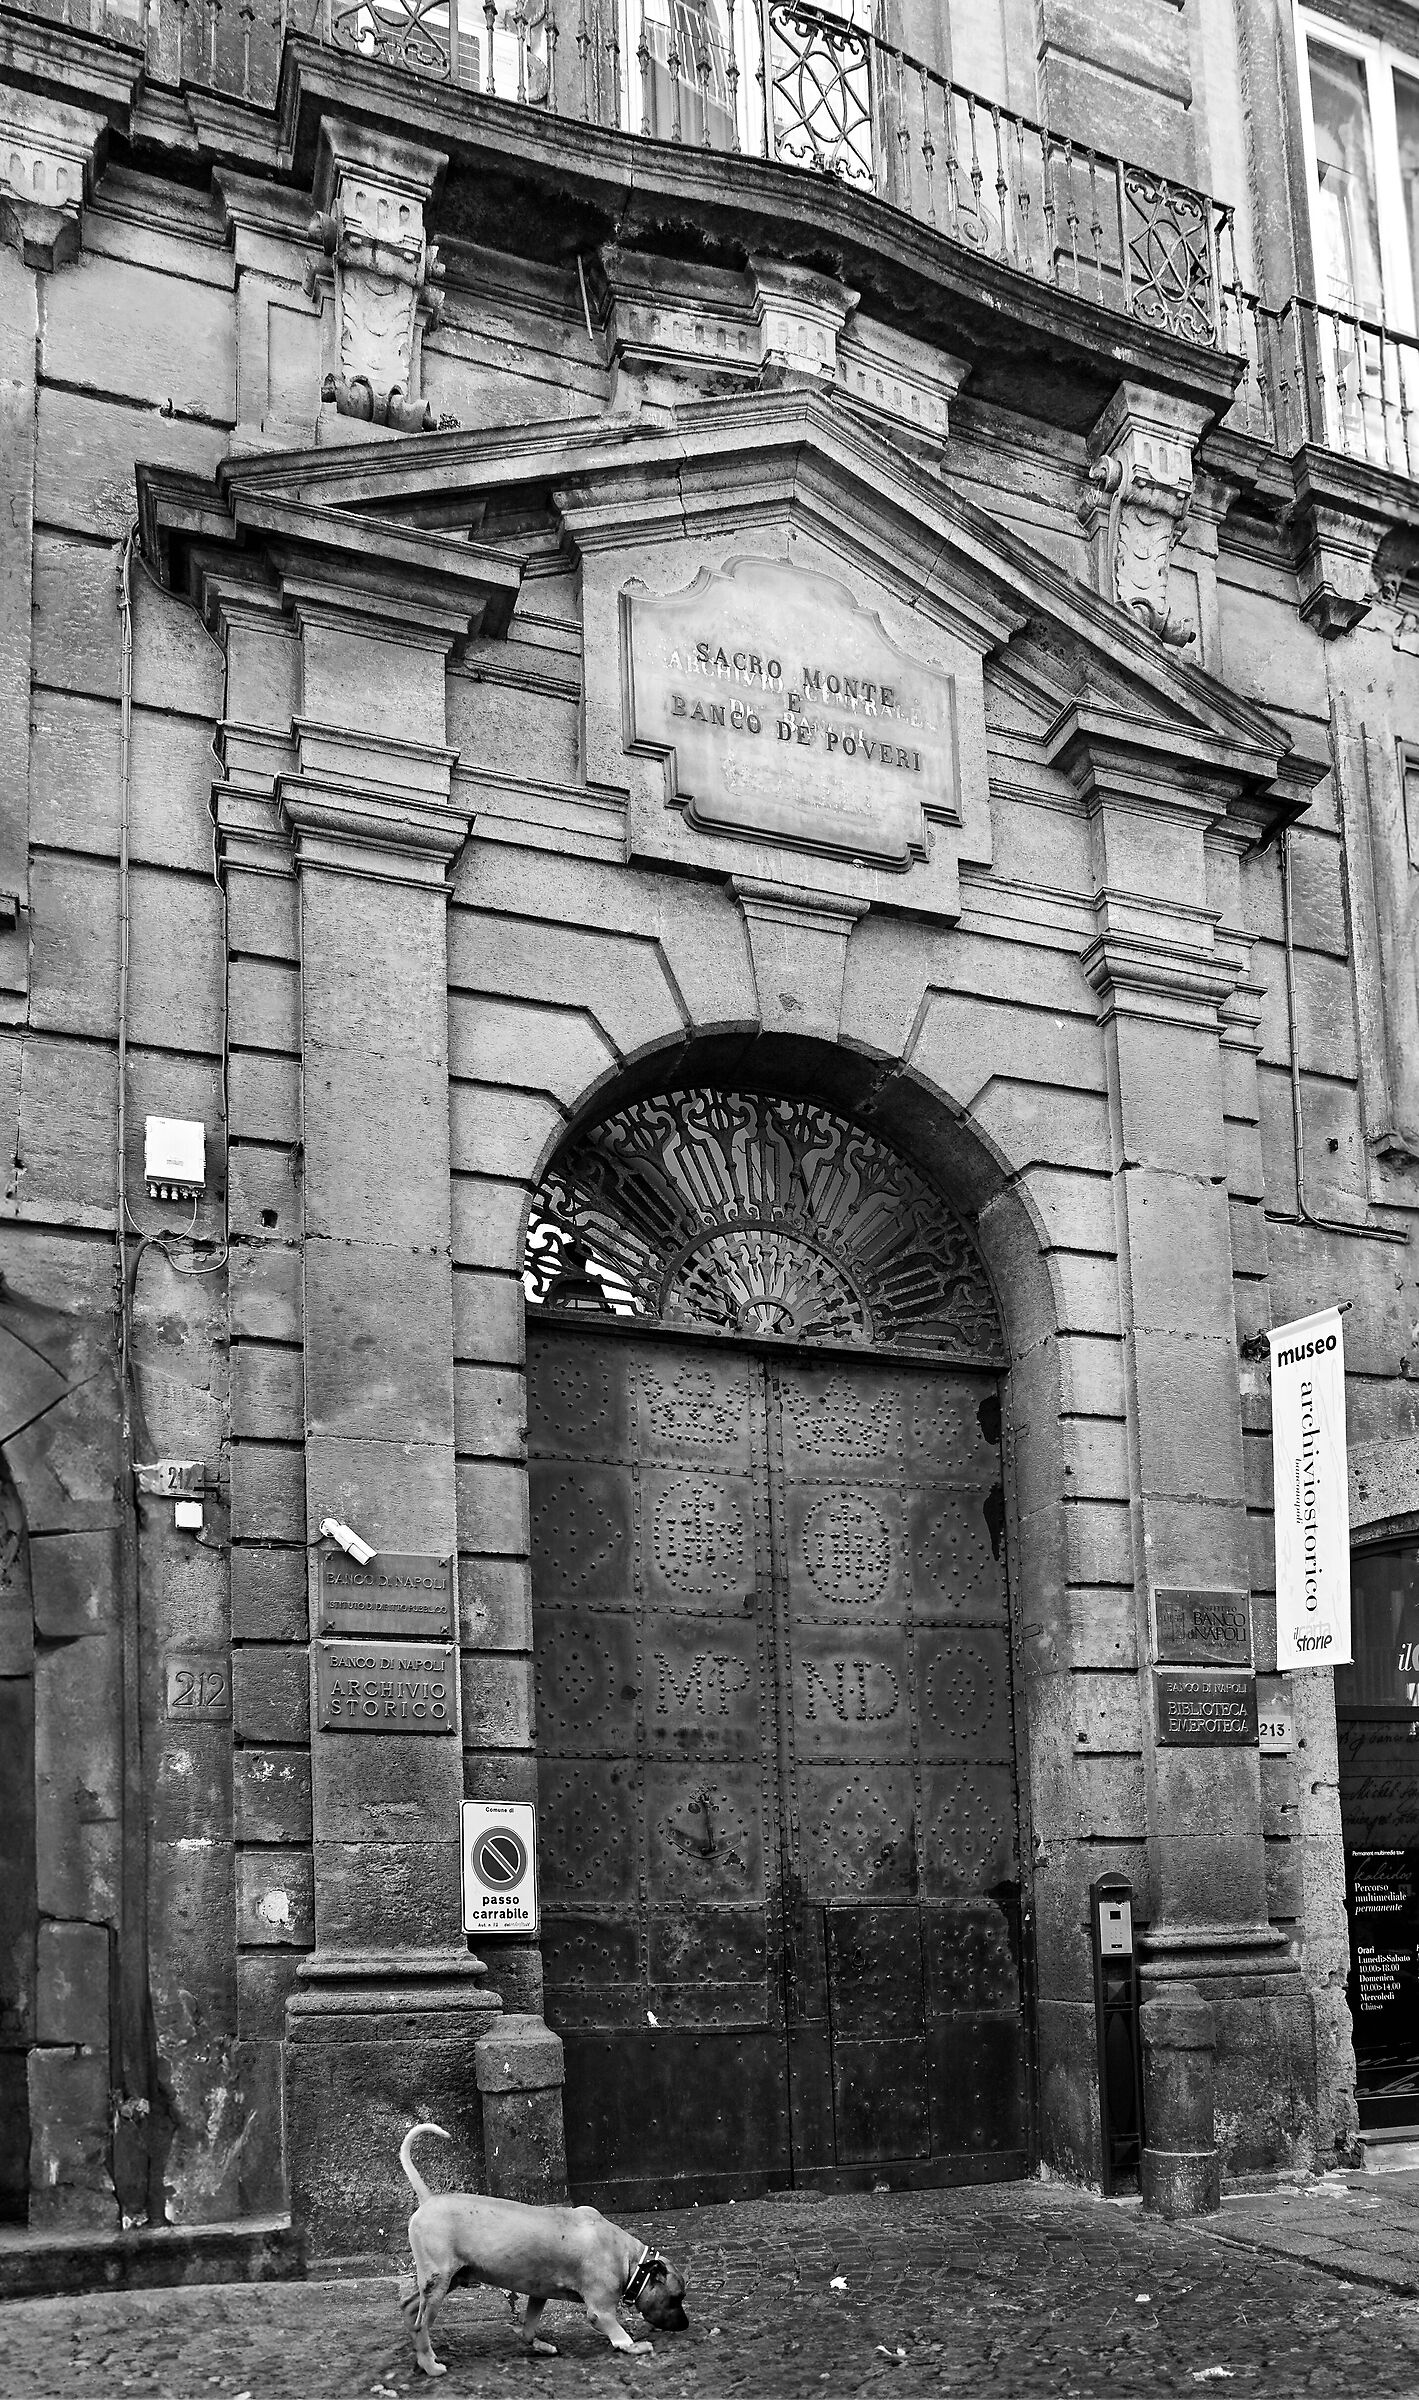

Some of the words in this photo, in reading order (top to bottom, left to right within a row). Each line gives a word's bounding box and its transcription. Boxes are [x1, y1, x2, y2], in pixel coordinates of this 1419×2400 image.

[696, 642, 782, 679] SACRO
[802, 667, 894, 708] MONTE
[787, 692, 801, 714] E
[671, 695, 761, 734] BANCO
[776, 720, 811, 746] DE
[825, 731, 921, 772] POVERI
[1277, 1334, 1337, 1368] museo
[1300, 1381, 1323, 1612] archiviostorico
[326, 1572, 374, 1585] BANCO
[378, 1574, 392, 1587] DI
[395, 1575, 446, 1590] NAPOLI
[328, 1600, 365, 1610] ISTITUTO
[376, 1602, 407, 1612] DIRITTO
[409, 1604, 448, 1614] PUBBLICO
[1193, 1611, 1246, 1627] BANCO
[1195, 1626, 1246, 1641] NAPOLI
[1296, 1634, 1333, 1652] storie
[329, 1655, 376, 1669] BANCO
[380, 1658, 395, 1670] DI
[398, 1659, 445, 1671] NAPOLI
[172, 1670, 227, 1708] 212
[331, 1679, 446, 1699] ARCHIVIO
[1166, 1682, 1199, 1693] BANCO
[1202, 1683, 1211, 1693] DI
[1214, 1683, 1247, 1693] NAPOLI
[330, 1699, 447, 1719] STORICO
[1167, 1701, 1248, 1716] BIBLIOTECA
[1168, 1718, 1249, 1733] EMEROTECA
[1259, 1722, 1285, 1737] 213
[1354, 1882, 1389, 1893] Percorso
[482, 1895, 520, 1907] passo
[1355, 1891, 1407, 1903] multimediale
[472, 1908, 529, 1920] carrabile
[1355, 1903, 1403, 1916] permanente
[1357, 1945, 1375, 1955] Orari
[1359, 1973, 1394, 1983] Domenica
